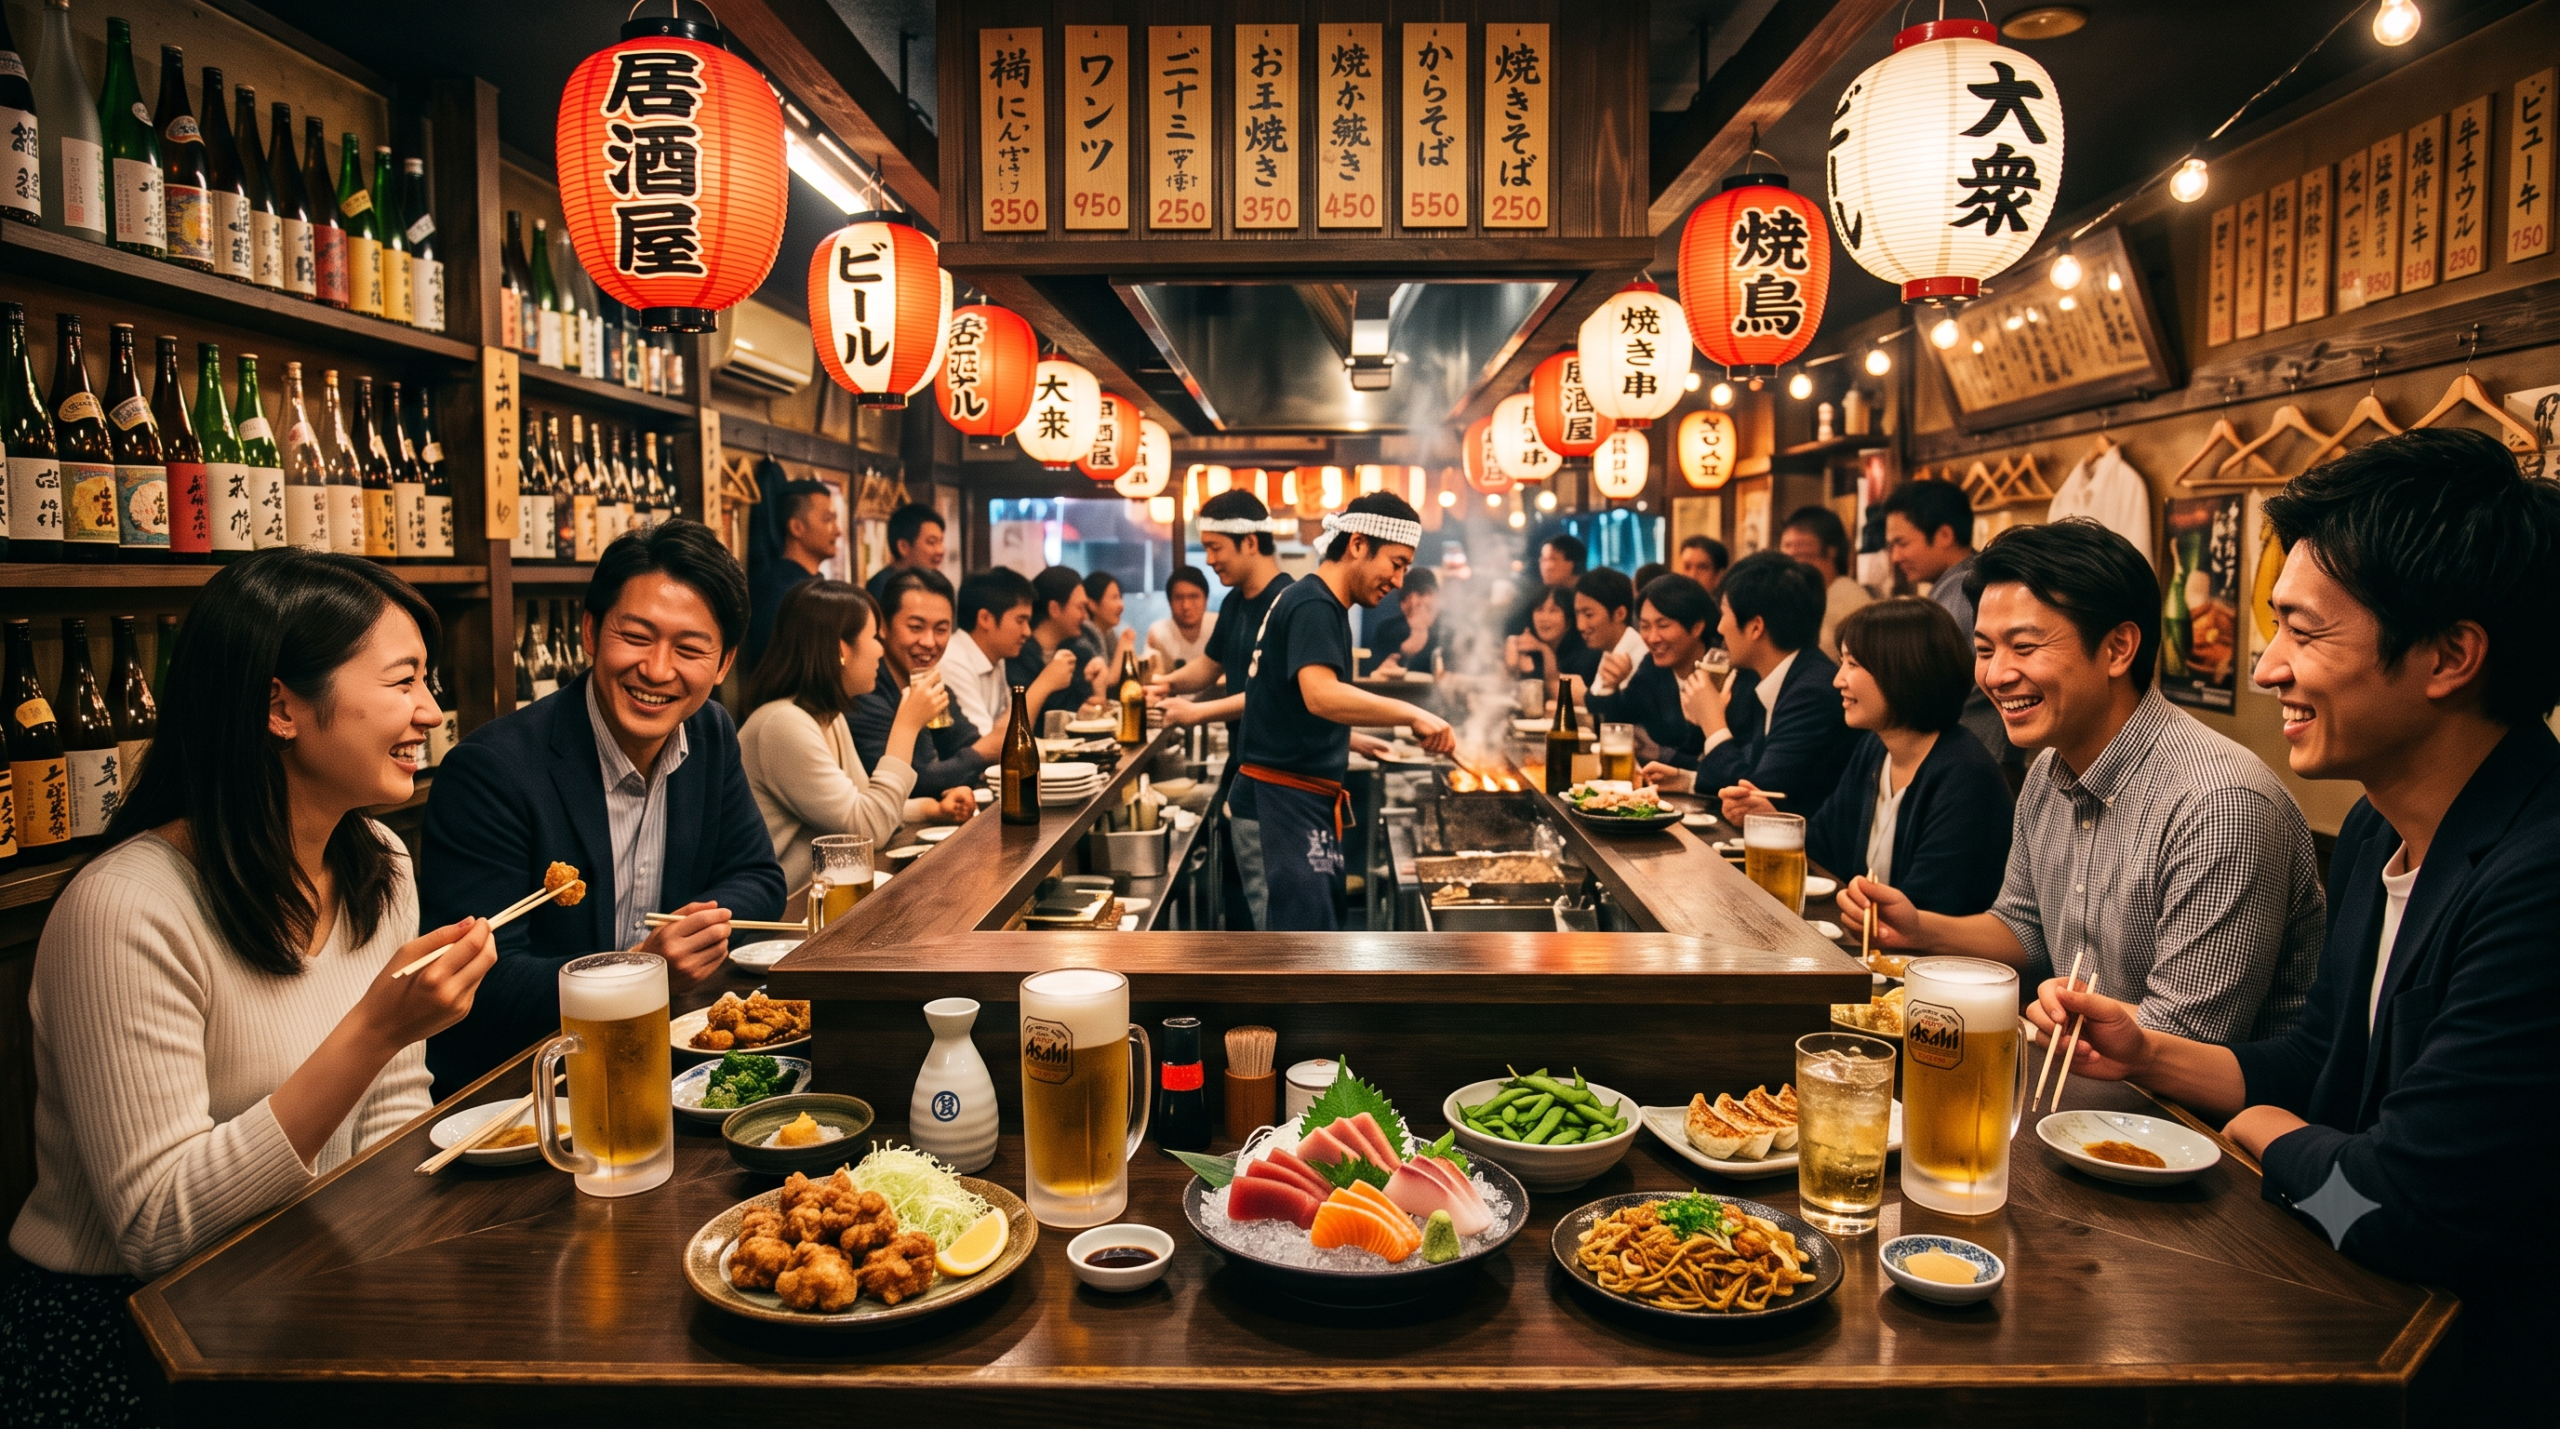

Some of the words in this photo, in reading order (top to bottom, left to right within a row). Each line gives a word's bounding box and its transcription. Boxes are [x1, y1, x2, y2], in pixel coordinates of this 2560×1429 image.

[1079, 53, 1115, 172] ワンツ
[1418, 41, 1455, 167] からそば
[1494, 43, 1541, 188] 焼きそば
[604, 51, 704, 275] 居酒屋
[1948, 60, 2048, 237] 大衆
[989, 198, 1039, 225] 350
[1073, 192, 1122, 217] 950
[1157, 198, 1206, 224] 250
[1242, 196, 1292, 222] 350
[1324, 192, 1376, 219] 450
[1410, 192, 1460, 217] 550
[1491, 194, 1542, 221] 250
[1735, 208, 1809, 336] 焼鳥
[839, 241, 890, 367] ビール
[1620, 306, 1661, 398] 焼き串
[1025, 1036, 1068, 1064] Asahi
[1910, 1021, 1959, 1050] Asahi
